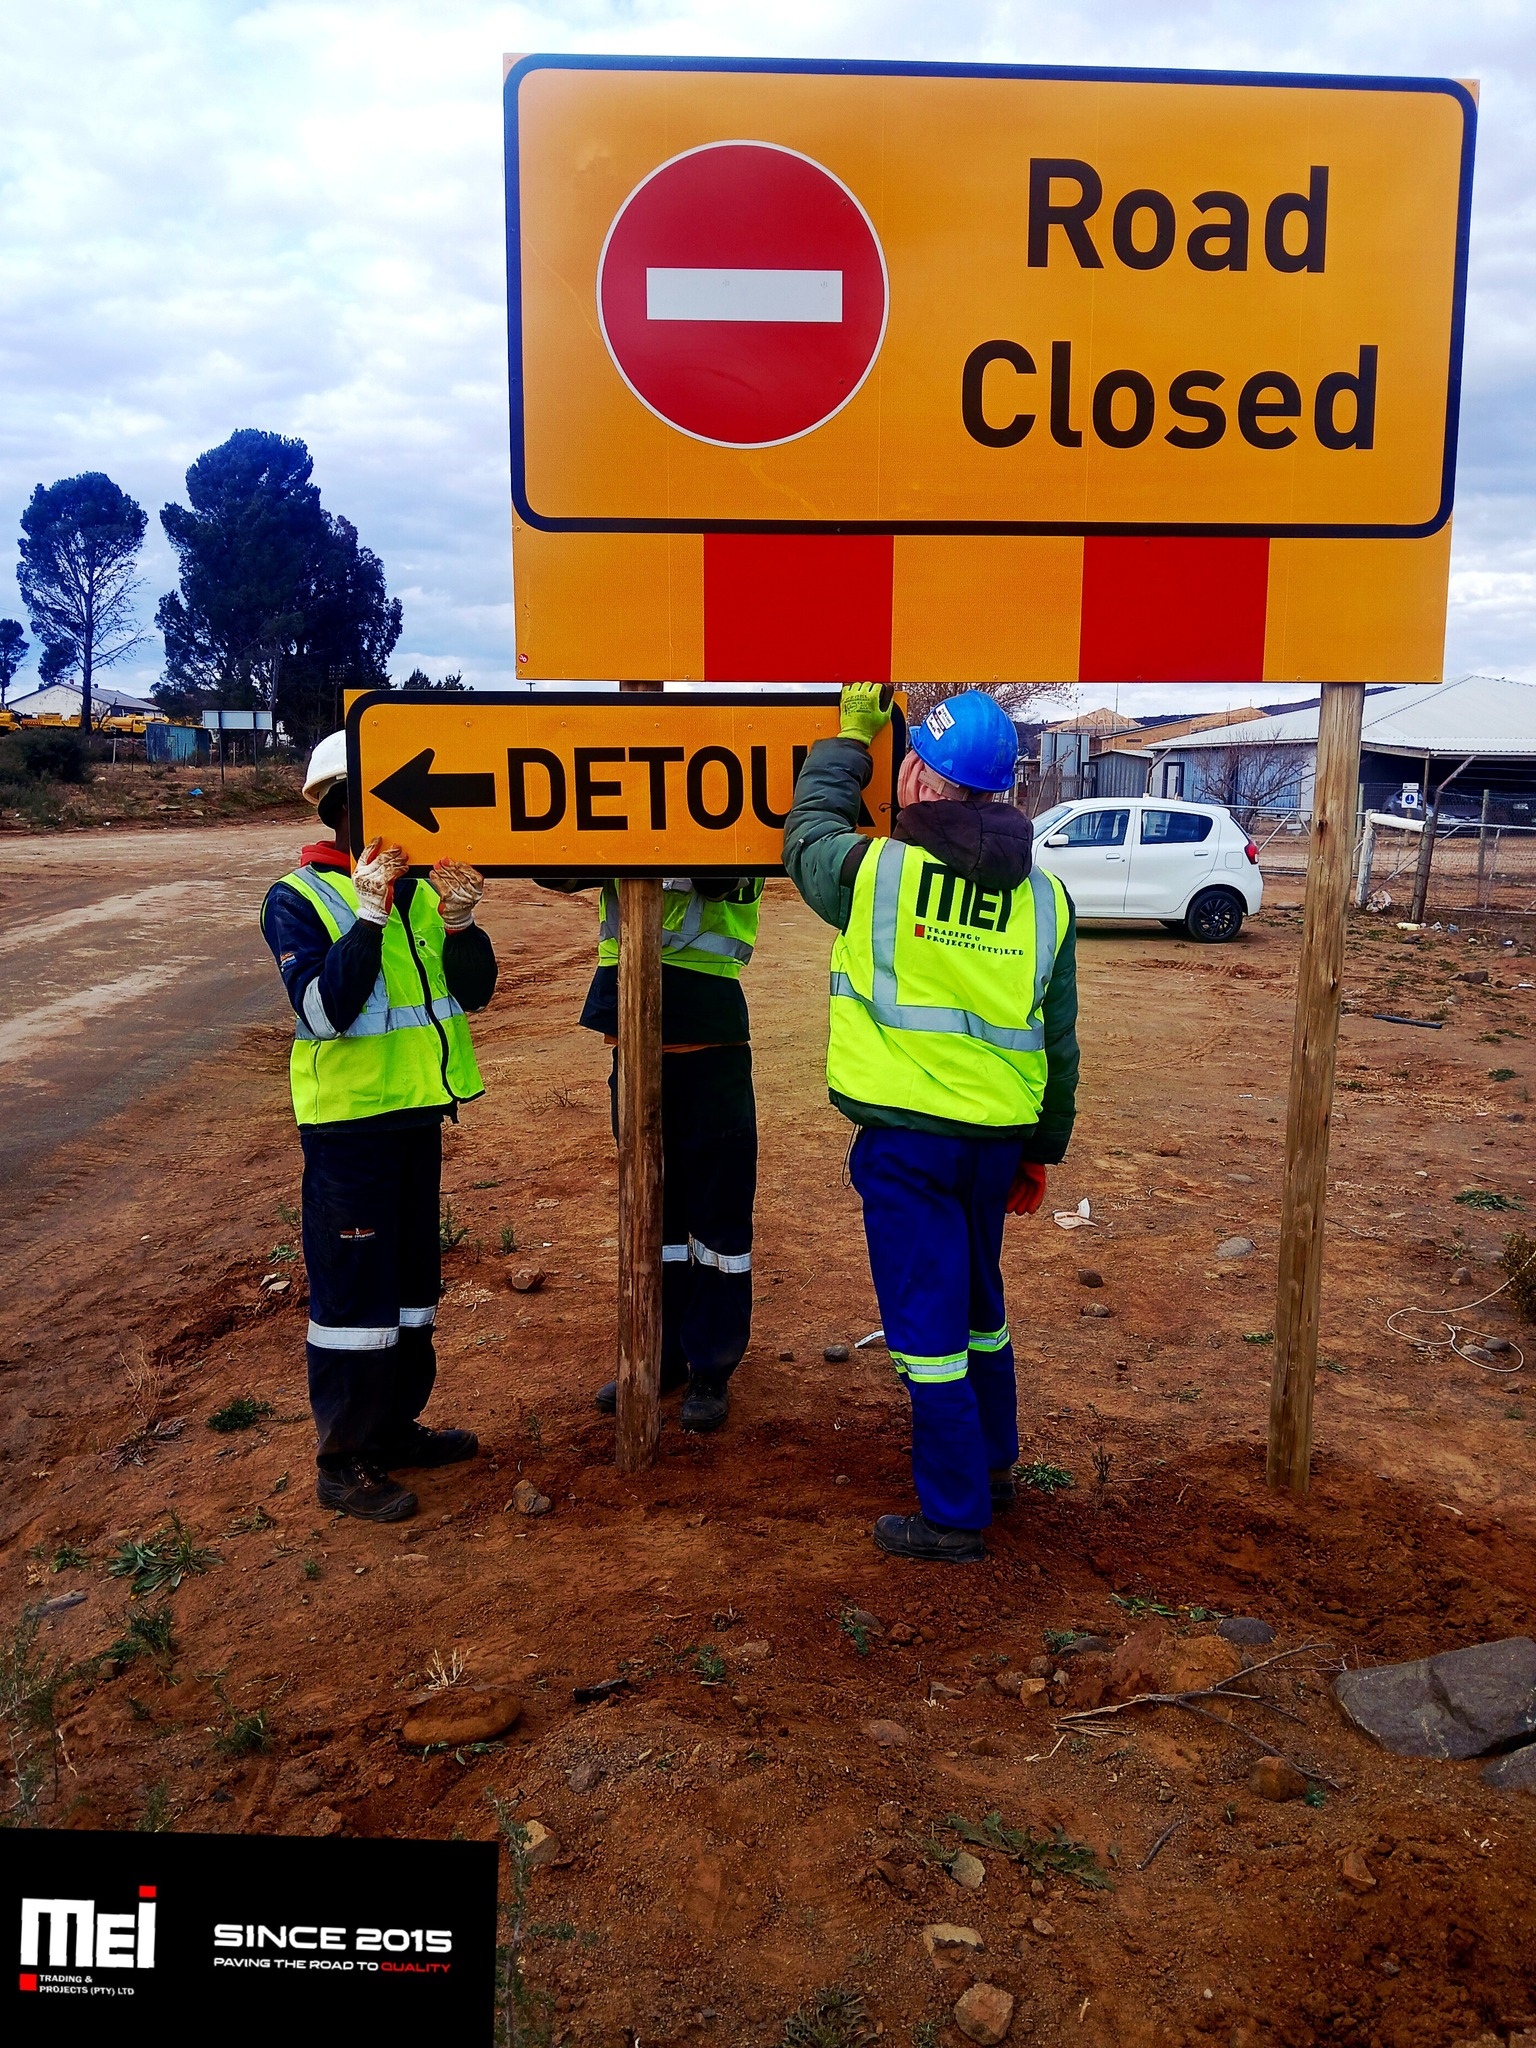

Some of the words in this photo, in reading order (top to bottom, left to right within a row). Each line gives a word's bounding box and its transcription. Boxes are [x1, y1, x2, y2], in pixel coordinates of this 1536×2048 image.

[1028, 158, 1328, 273] Road
[962, 340, 1377, 450] Closed
[508, 746, 876, 832] DETOU
[927, 926, 972, 940] TRADING
[927, 935, 976, 948] PROJECTS
